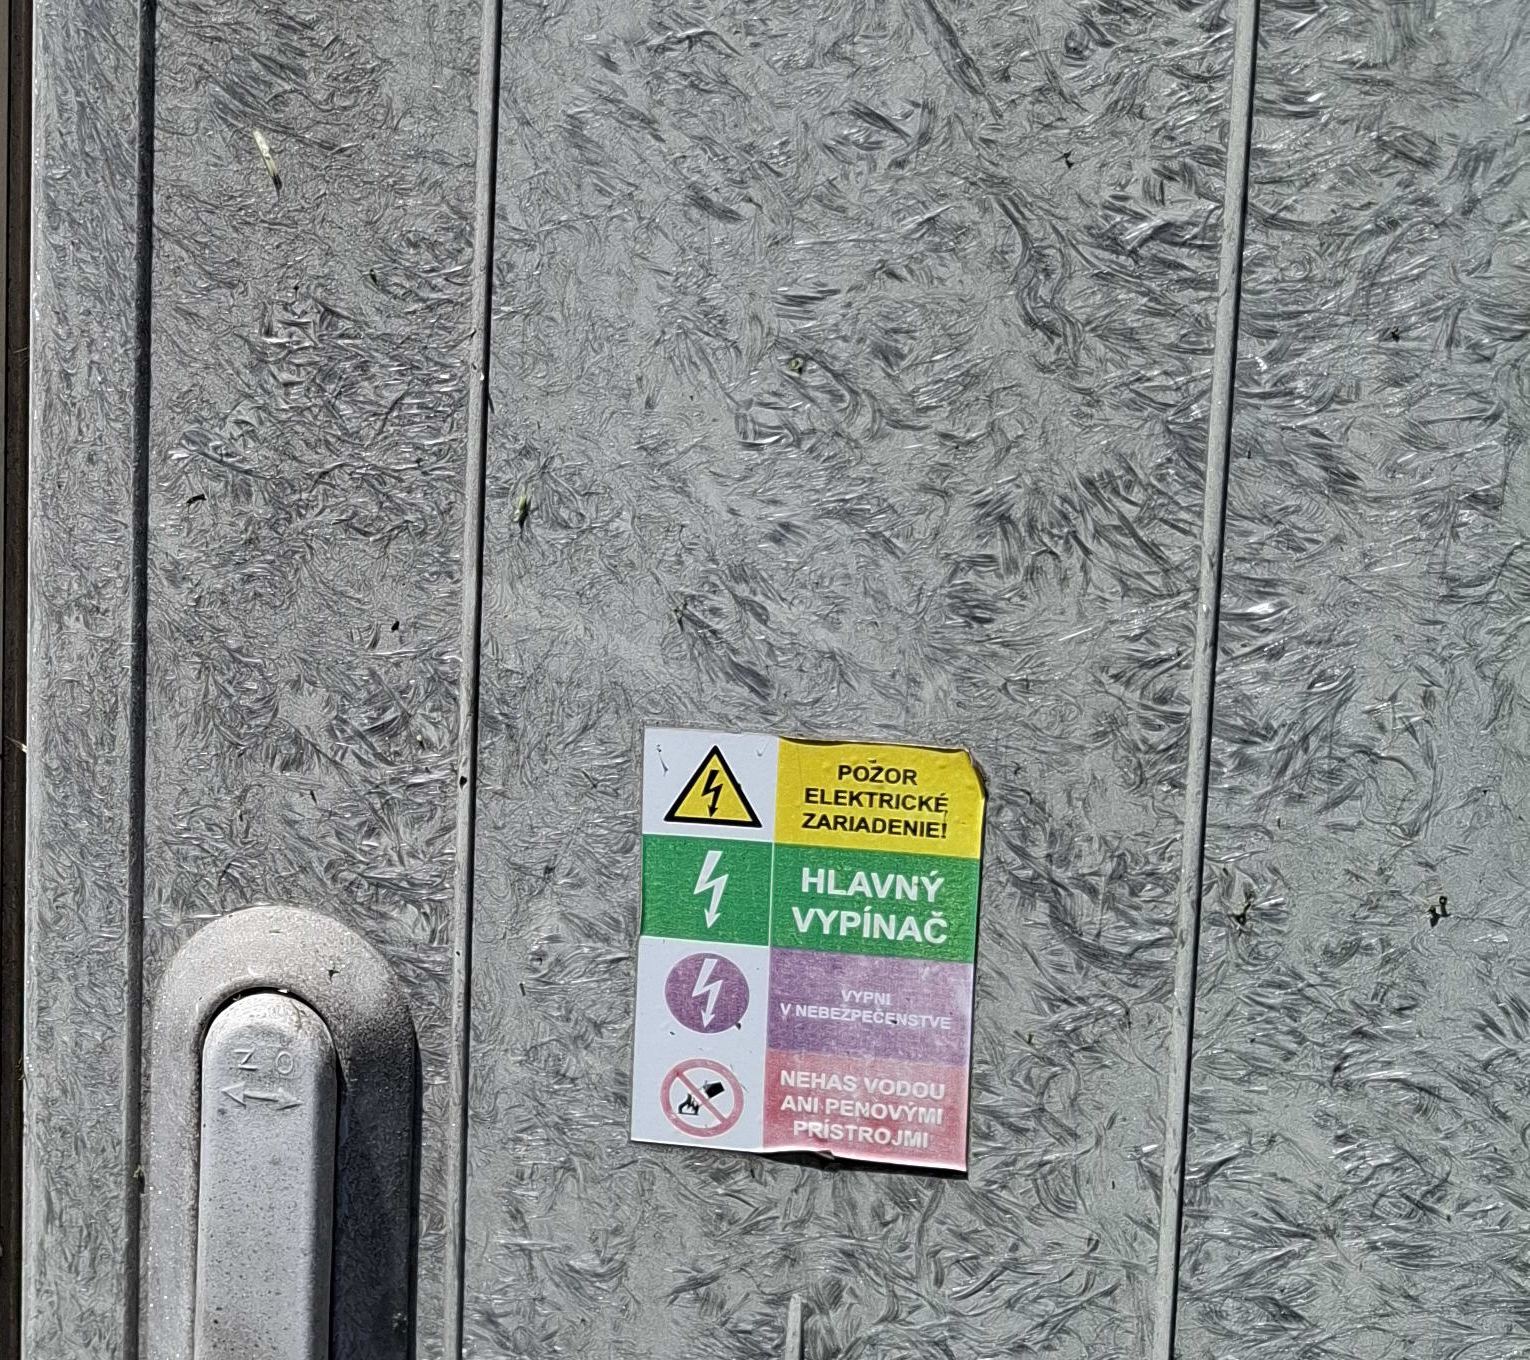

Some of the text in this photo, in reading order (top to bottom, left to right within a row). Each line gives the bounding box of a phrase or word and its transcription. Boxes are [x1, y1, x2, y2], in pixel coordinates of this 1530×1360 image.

[837, 764, 918, 786] POZOR
[804, 788, 949, 813] ELEKTRICKÉ
[801, 813, 947, 839] ZARIADENIE!
[801, 867, 945, 903] HLAVNÝ
[792, 906, 948, 944] VYPÍNAČ
[841, 989, 891, 1006] VYPNI
[780, 1002, 951, 1030] V NEBEZPEČENSTVE
[780, 1069, 946, 1101] NEHAS VODOU
[780, 1095, 943, 1125] ANI PENOVÝMI
[793, 1119, 928, 1148] PRÍSTROJMI
